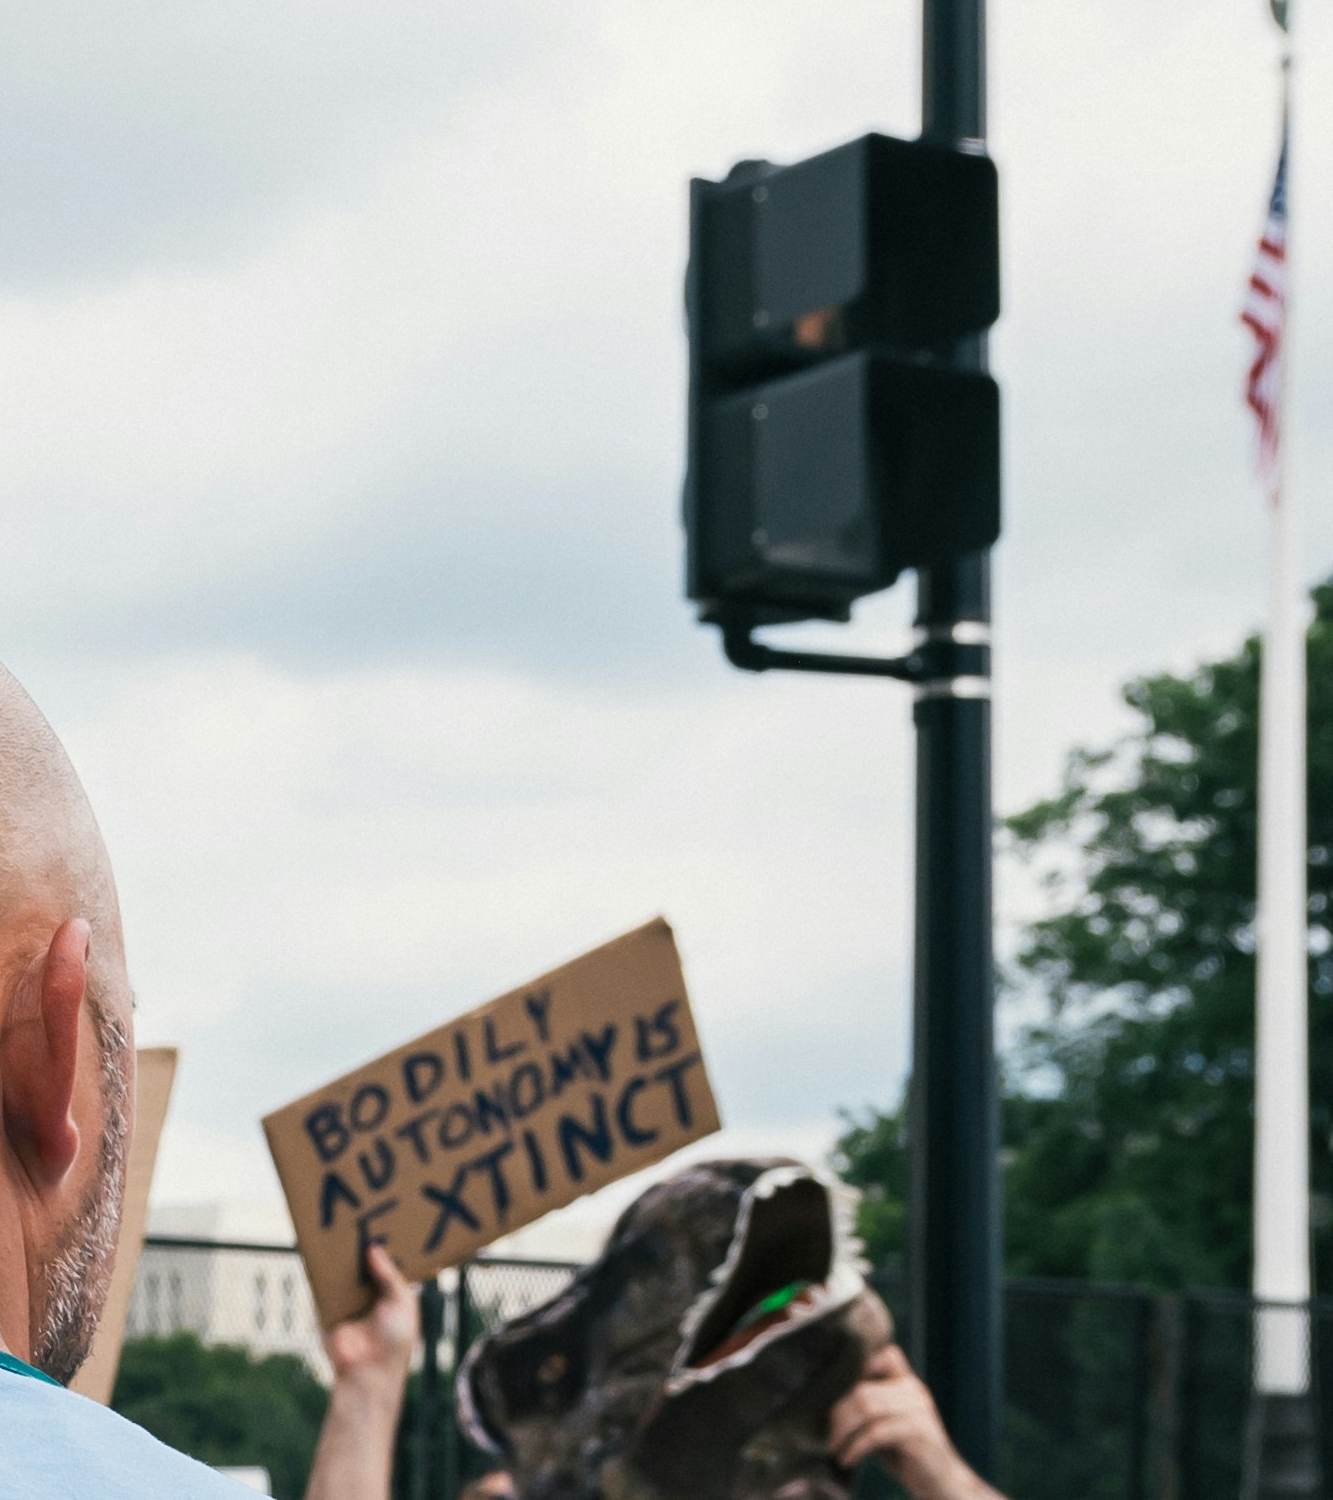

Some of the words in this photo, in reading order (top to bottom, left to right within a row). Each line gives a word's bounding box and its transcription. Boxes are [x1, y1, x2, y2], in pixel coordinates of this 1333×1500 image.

[302, 988, 555, 1166] BODILY
[318, 1022, 617, 1230] AUTONOMY
[633, 1001, 682, 1062] IS
[355, 1050, 703, 1285] EXTINCT
